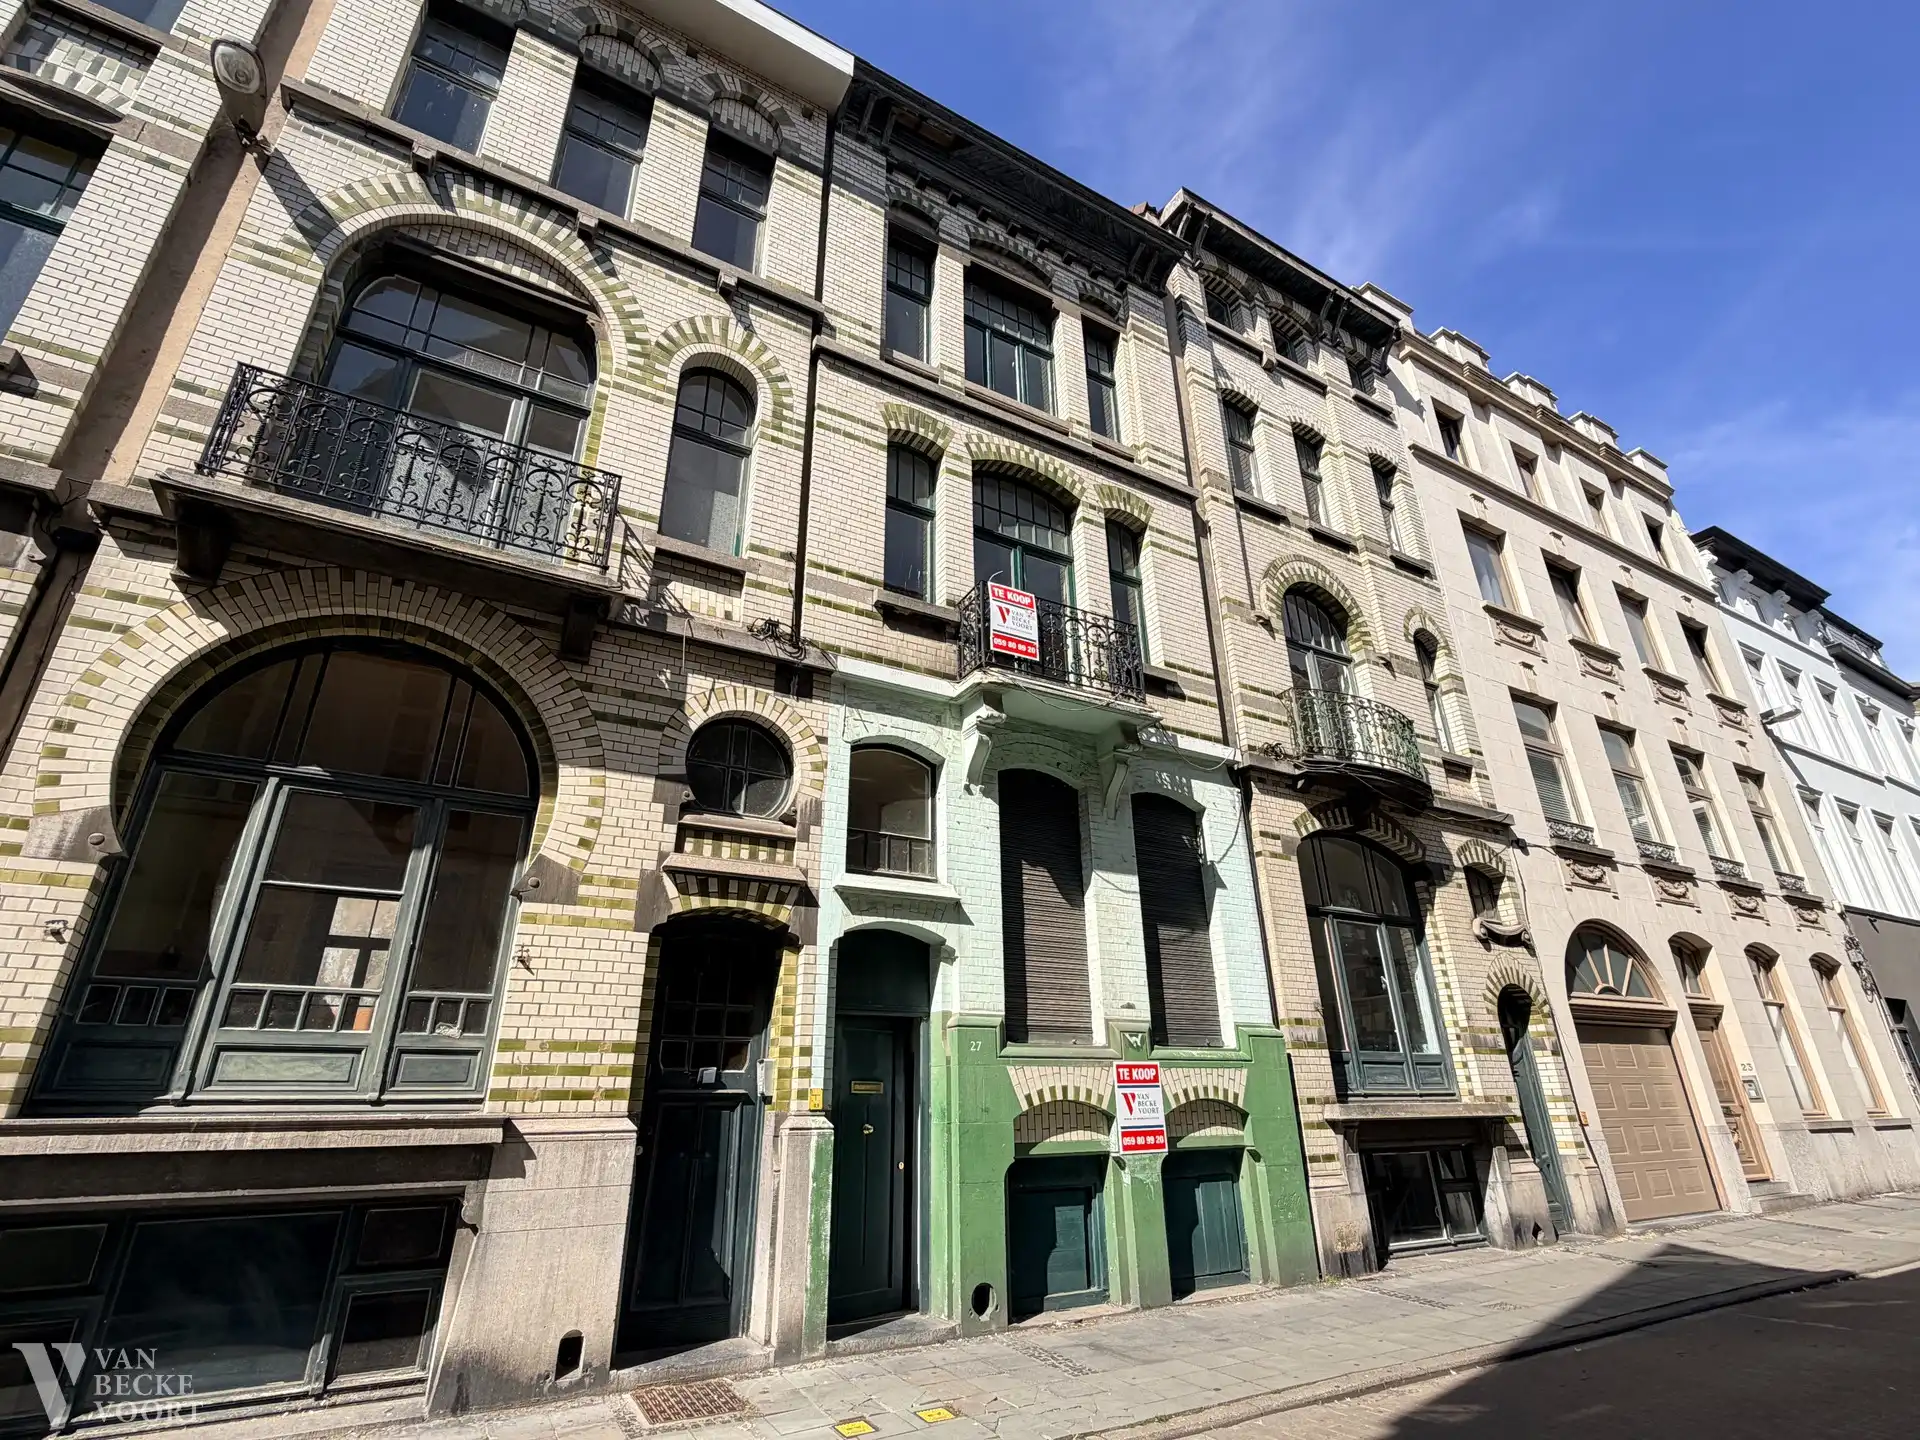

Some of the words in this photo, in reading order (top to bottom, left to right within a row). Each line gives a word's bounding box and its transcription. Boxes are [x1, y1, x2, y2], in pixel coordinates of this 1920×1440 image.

[992, 587, 1005, 598] TE
[1006, 591, 1031, 605] KOOP
[993, 637, 1007, 647] 059
[1007, 641, 1017, 649] 80
[1028, 646, 1035, 654] 20
[970, 1040, 982, 1051] 27
[1740, 1063, 1753, 1071] 23
[1118, 1068, 1130, 1080] TE
[1132, 1067, 1156, 1080] KOOP
[1122, 1136, 1136, 1146] 059
[1136, 1136, 1145, 1145] 80
[1146, 1135, 1155, 1144] 99
[1155, 1135, 1164, 1144] 20
